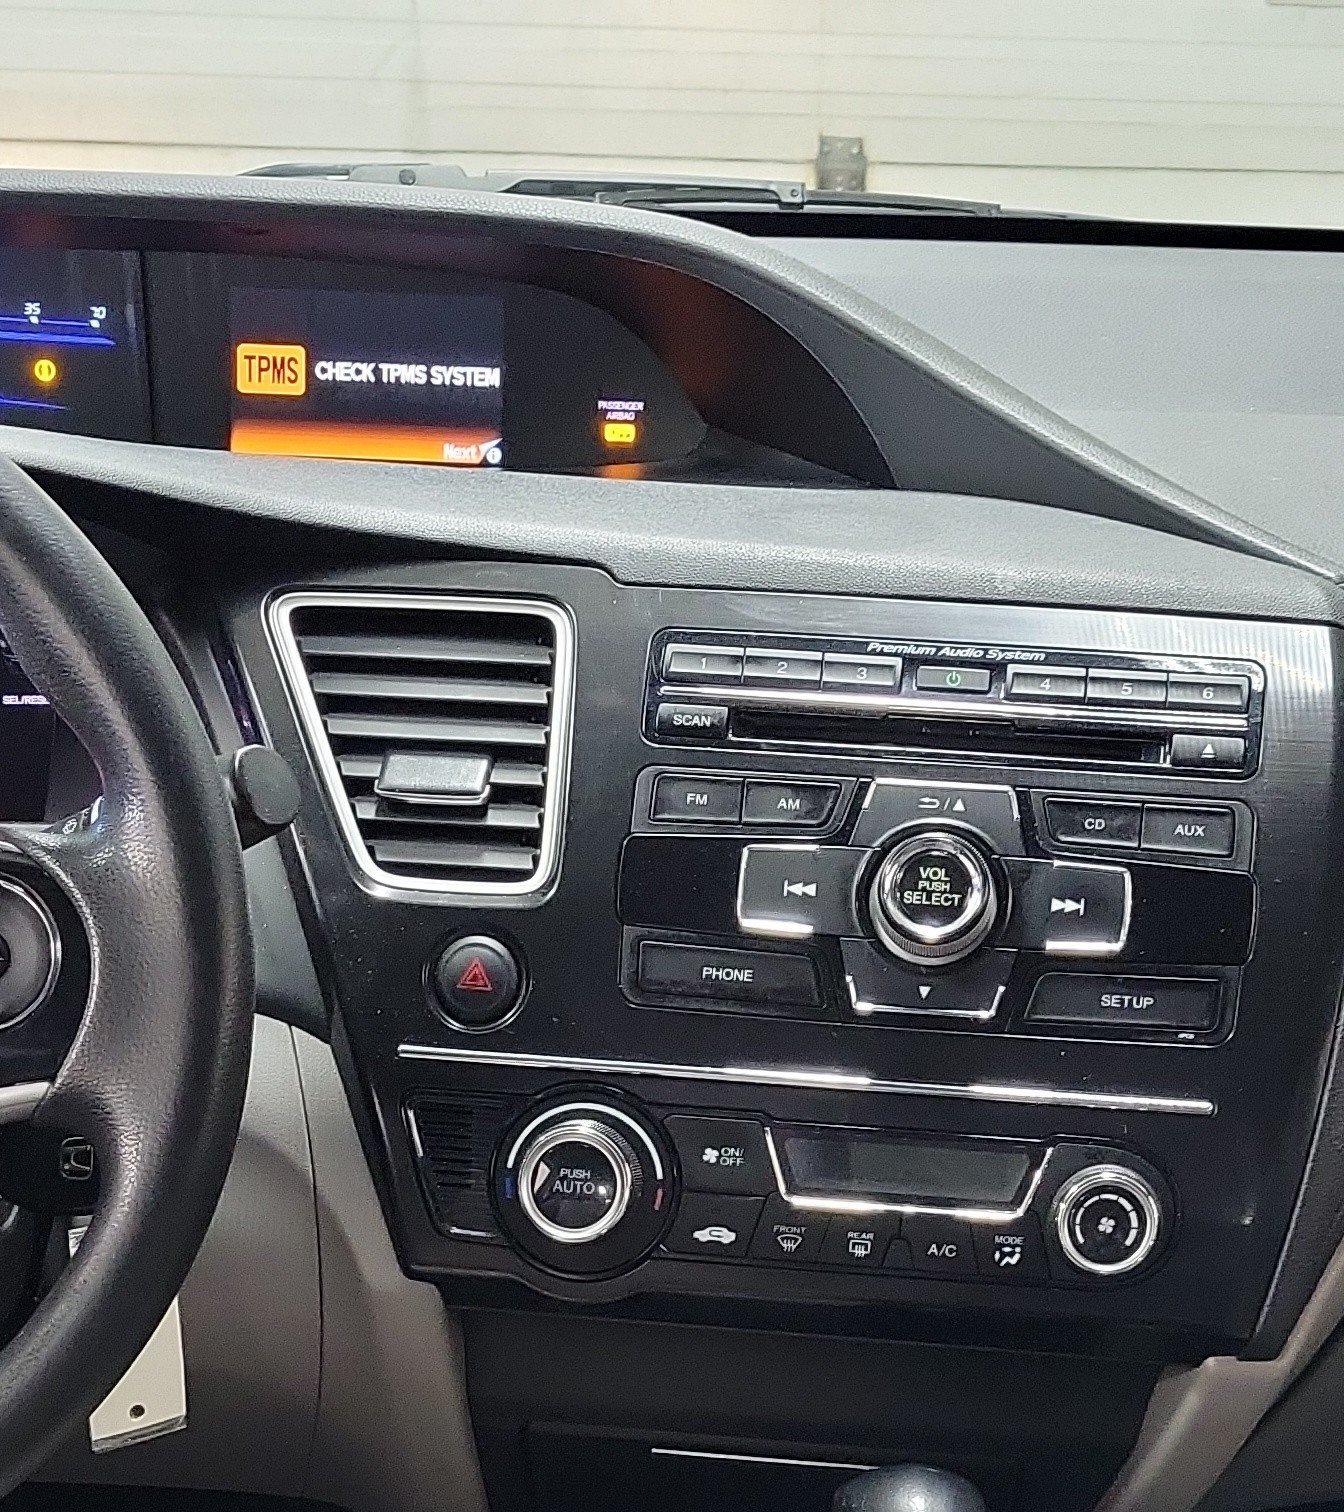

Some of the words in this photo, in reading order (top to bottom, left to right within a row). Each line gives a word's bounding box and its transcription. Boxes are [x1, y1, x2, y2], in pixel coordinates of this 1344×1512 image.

[24, 303, 41, 315] 35
[90, 306, 106, 319] 70
[244, 353, 299, 385] TPMS
[315, 361, 376, 383] CHECK
[380, 363, 427, 386] TPMS
[431, 365, 501, 388] SYSTEM
[598, 400, 644, 411] PASSENGER
[606, 411, 636, 420] AIRBAG
[443, 443, 479, 461] Next
[867, 642, 935, 659] Premium
[937, 646, 984, 660] Audio
[987, 648, 1046, 664] System
[700, 656, 707, 671] 1
[776, 661, 788, 674] 2
[856, 666, 868, 680] 3
[1040, 678, 1051, 692] 4
[1121, 683, 1133, 696] 5
[1202, 687, 1214, 700] 6
[672, 712, 712, 729] SCAN
[686, 793, 709, 807] FM
[776, 797, 801, 811] AM
[1084, 817, 1106, 831] CD
[1173, 823, 1205, 838] AUX
[918, 867, 951, 881] VOL
[918, 880, 951, 892] PUSH
[903, 891, 962, 908] SELECT
[702, 966, 754, 984] PHONE
[1100, 993, 1155, 1010] SETUP
[720, 1148, 745, 1158] ON/
[720, 1157, 744, 1167] OFF
[559, 1168, 592, 1180] PUSH
[552, 1180, 596, 1195] AUTO
[773, 1225, 806, 1235] FRONT
[847, 1231, 874, 1241] REAR
[994, 1235, 1025, 1246] MODE
[927, 1243, 958, 1258] A/C
